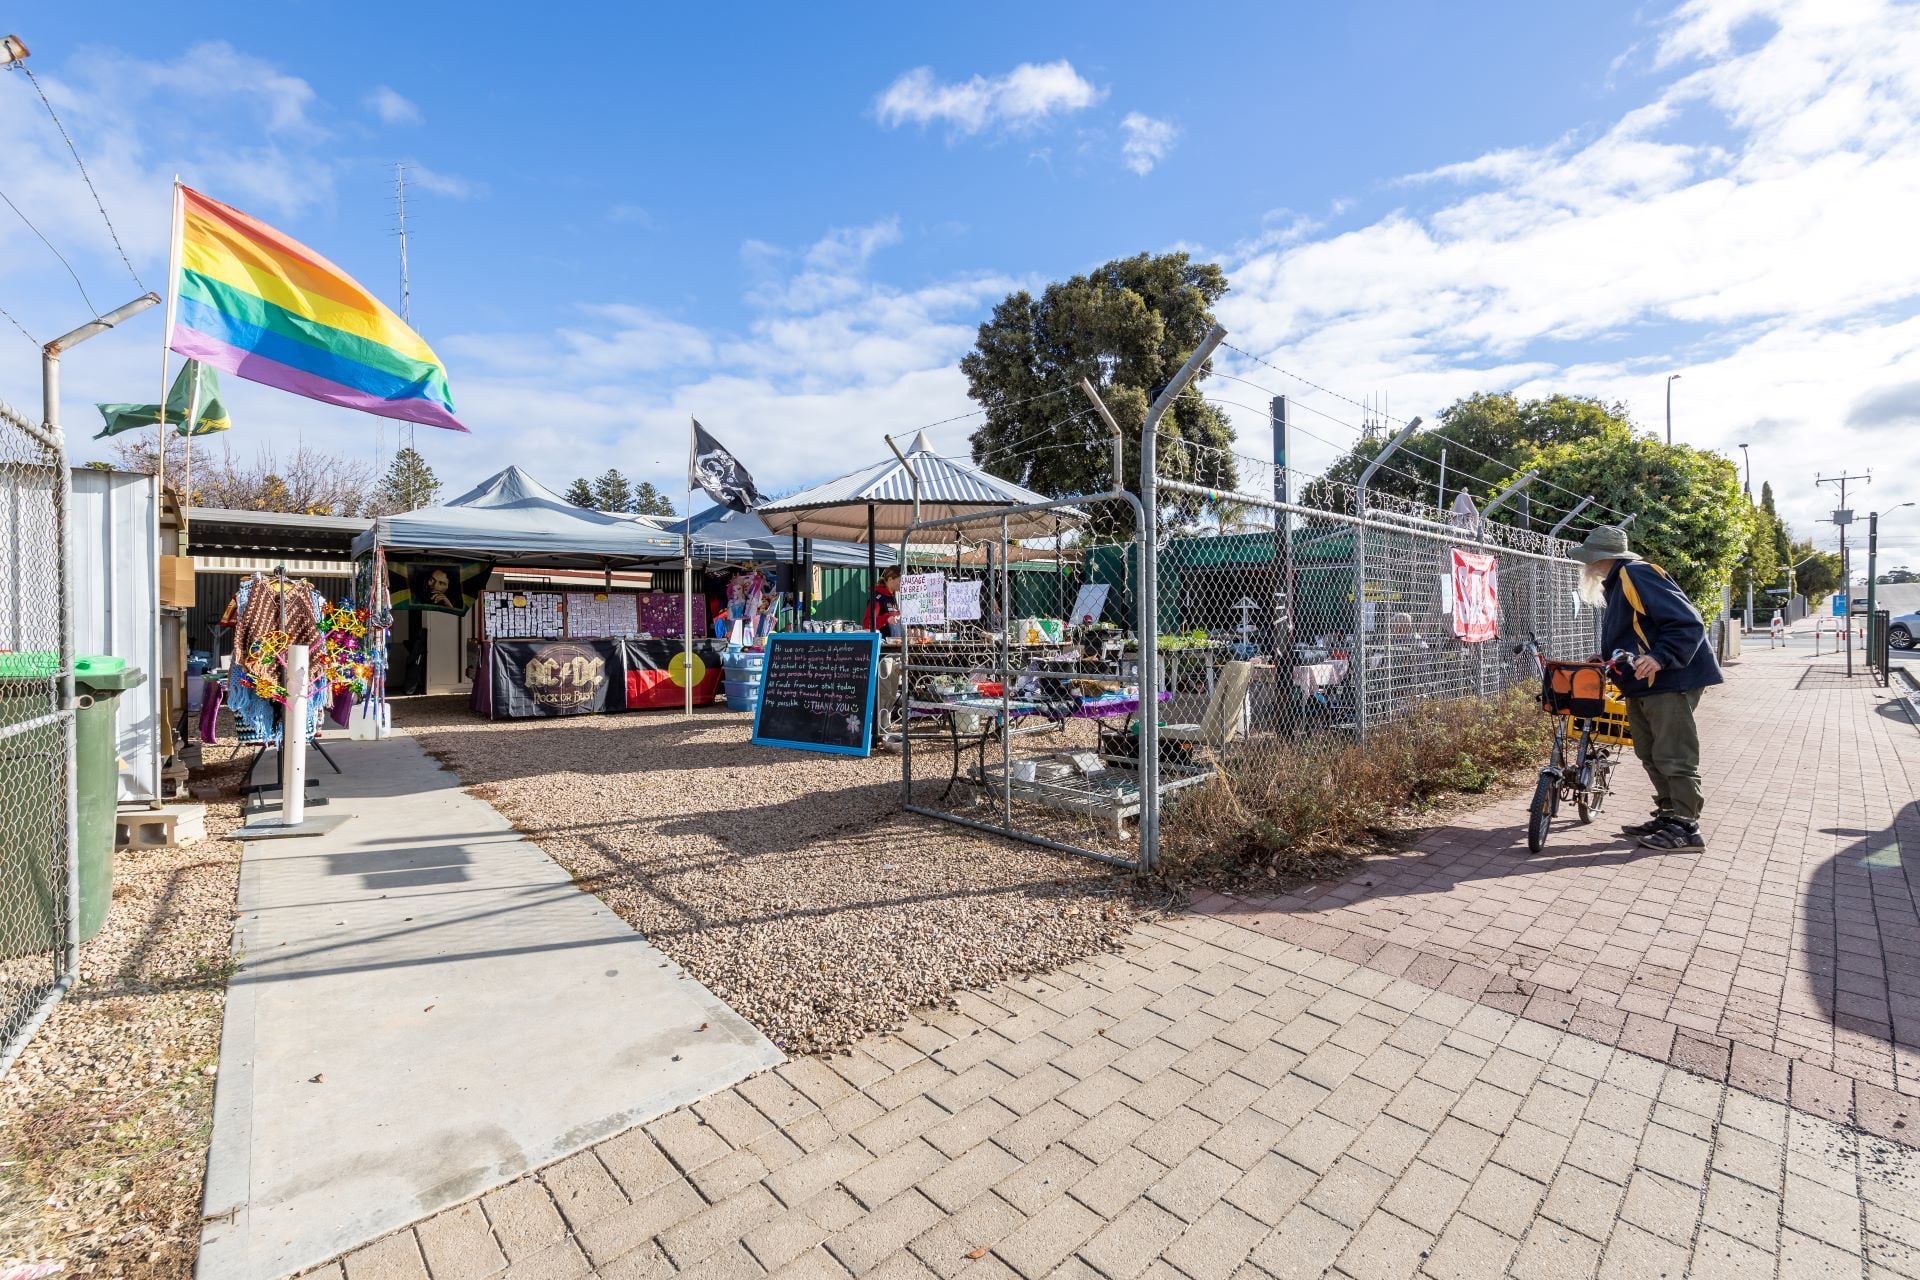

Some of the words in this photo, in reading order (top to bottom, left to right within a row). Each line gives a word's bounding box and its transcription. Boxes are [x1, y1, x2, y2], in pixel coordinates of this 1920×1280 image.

[900, 576, 926, 586] SAUSAGE
[900, 586, 908, 594] IN
[774, 643, 782, 653] Hi
[808, 656, 824, 664] going
[833, 654, 852, 662] Japan
[808, 662, 817, 670] the
[820, 663, 830, 671] end
[830, 664, 837, 673] of
[839, 665, 849, 673] the
[793, 680, 806, 688] from
[821, 682, 835, 690] stall
[837, 681, 856, 694] today
[783, 690, 797, 698] going
[799, 689, 821, 697] towards
[824, 691, 843, 701] making
[811, 700, 834, 711] THANK
[836, 702, 850, 712] YOU
